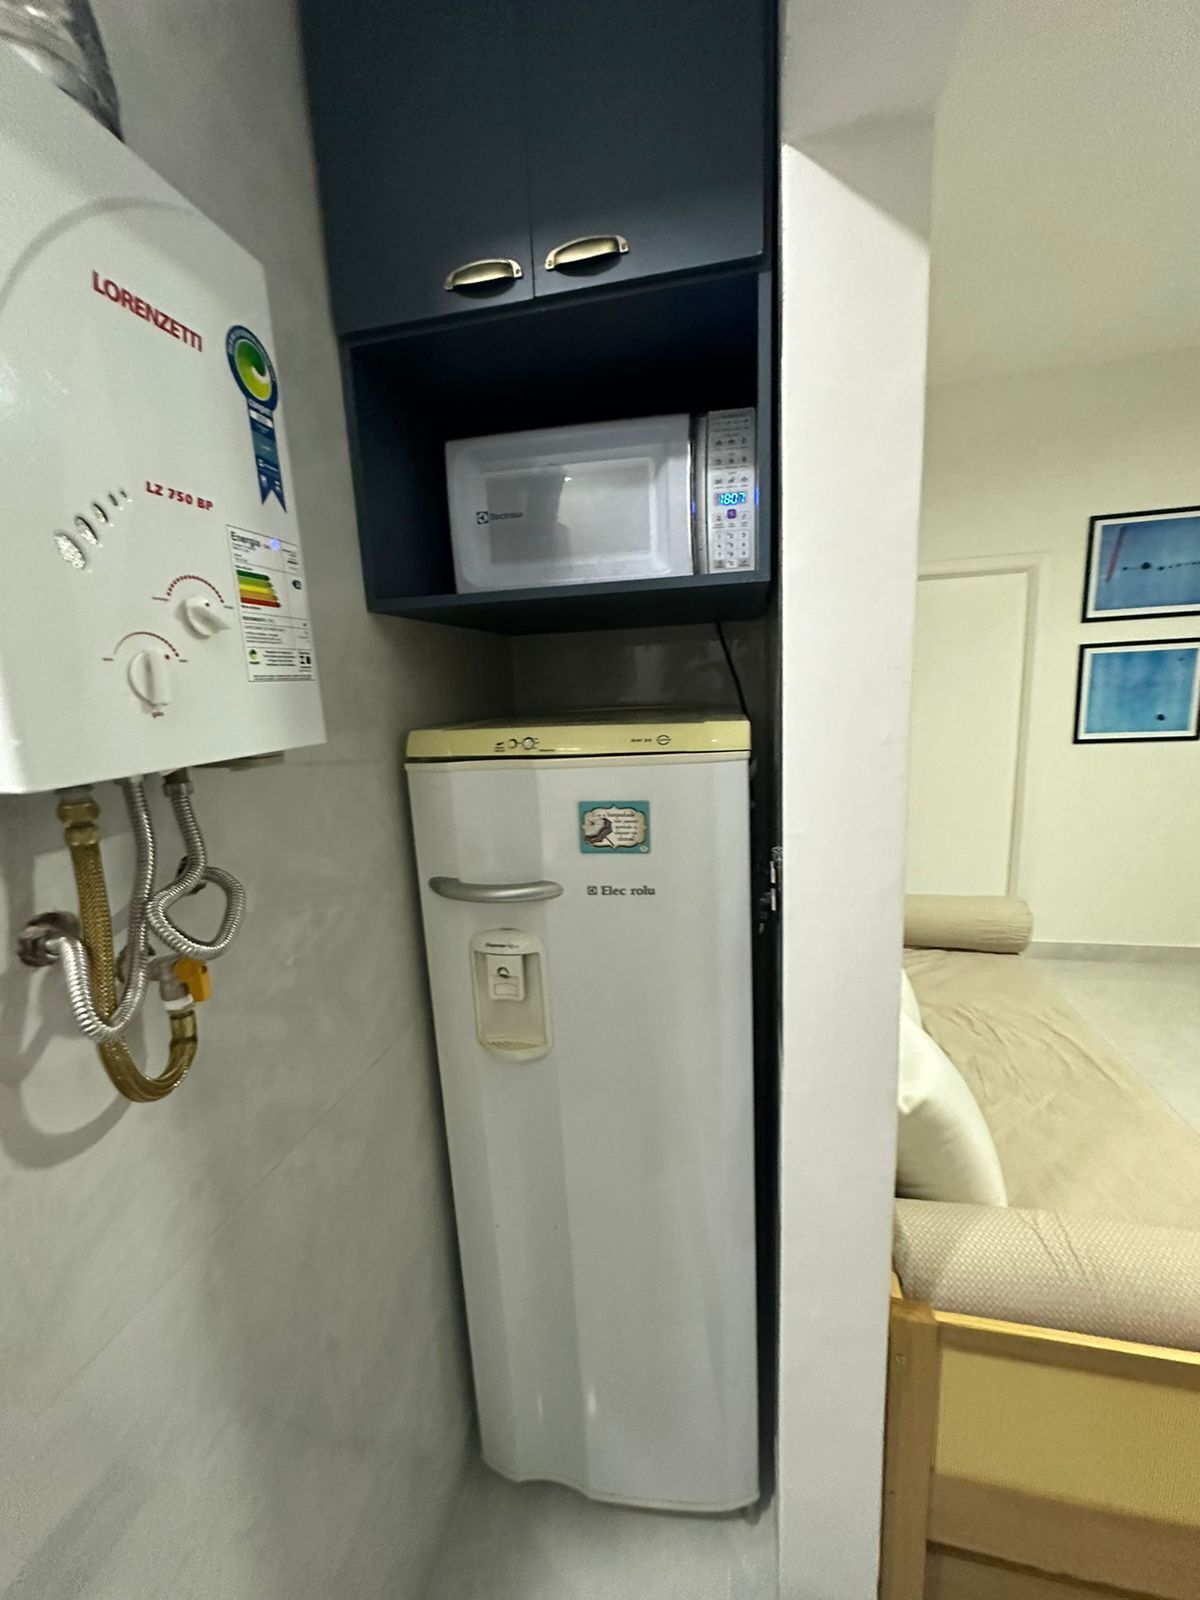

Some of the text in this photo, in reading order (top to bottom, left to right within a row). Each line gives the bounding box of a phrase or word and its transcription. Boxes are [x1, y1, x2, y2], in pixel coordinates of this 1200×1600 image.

[92, 269, 203, 352] LORENZETTI
[145, 481, 213, 511] LZ 750 BP
